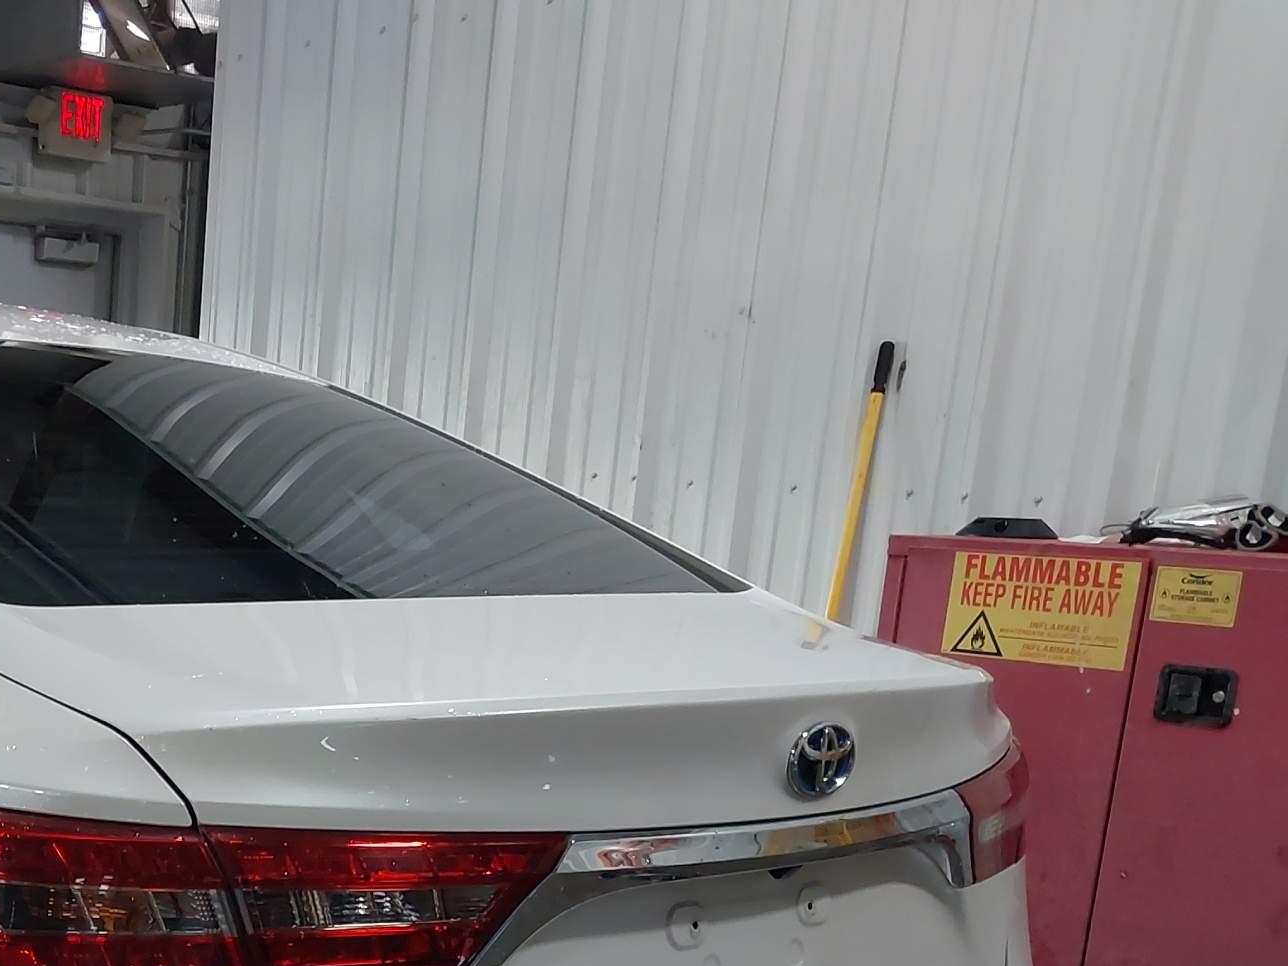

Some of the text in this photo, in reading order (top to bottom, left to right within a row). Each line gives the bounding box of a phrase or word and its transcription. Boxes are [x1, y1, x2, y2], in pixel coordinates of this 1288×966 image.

[60, 92, 105, 142] EXIT
[964, 554, 1125, 589] FLAMMABLE
[960, 581, 1120, 617] KEEP FIRE AWAY
